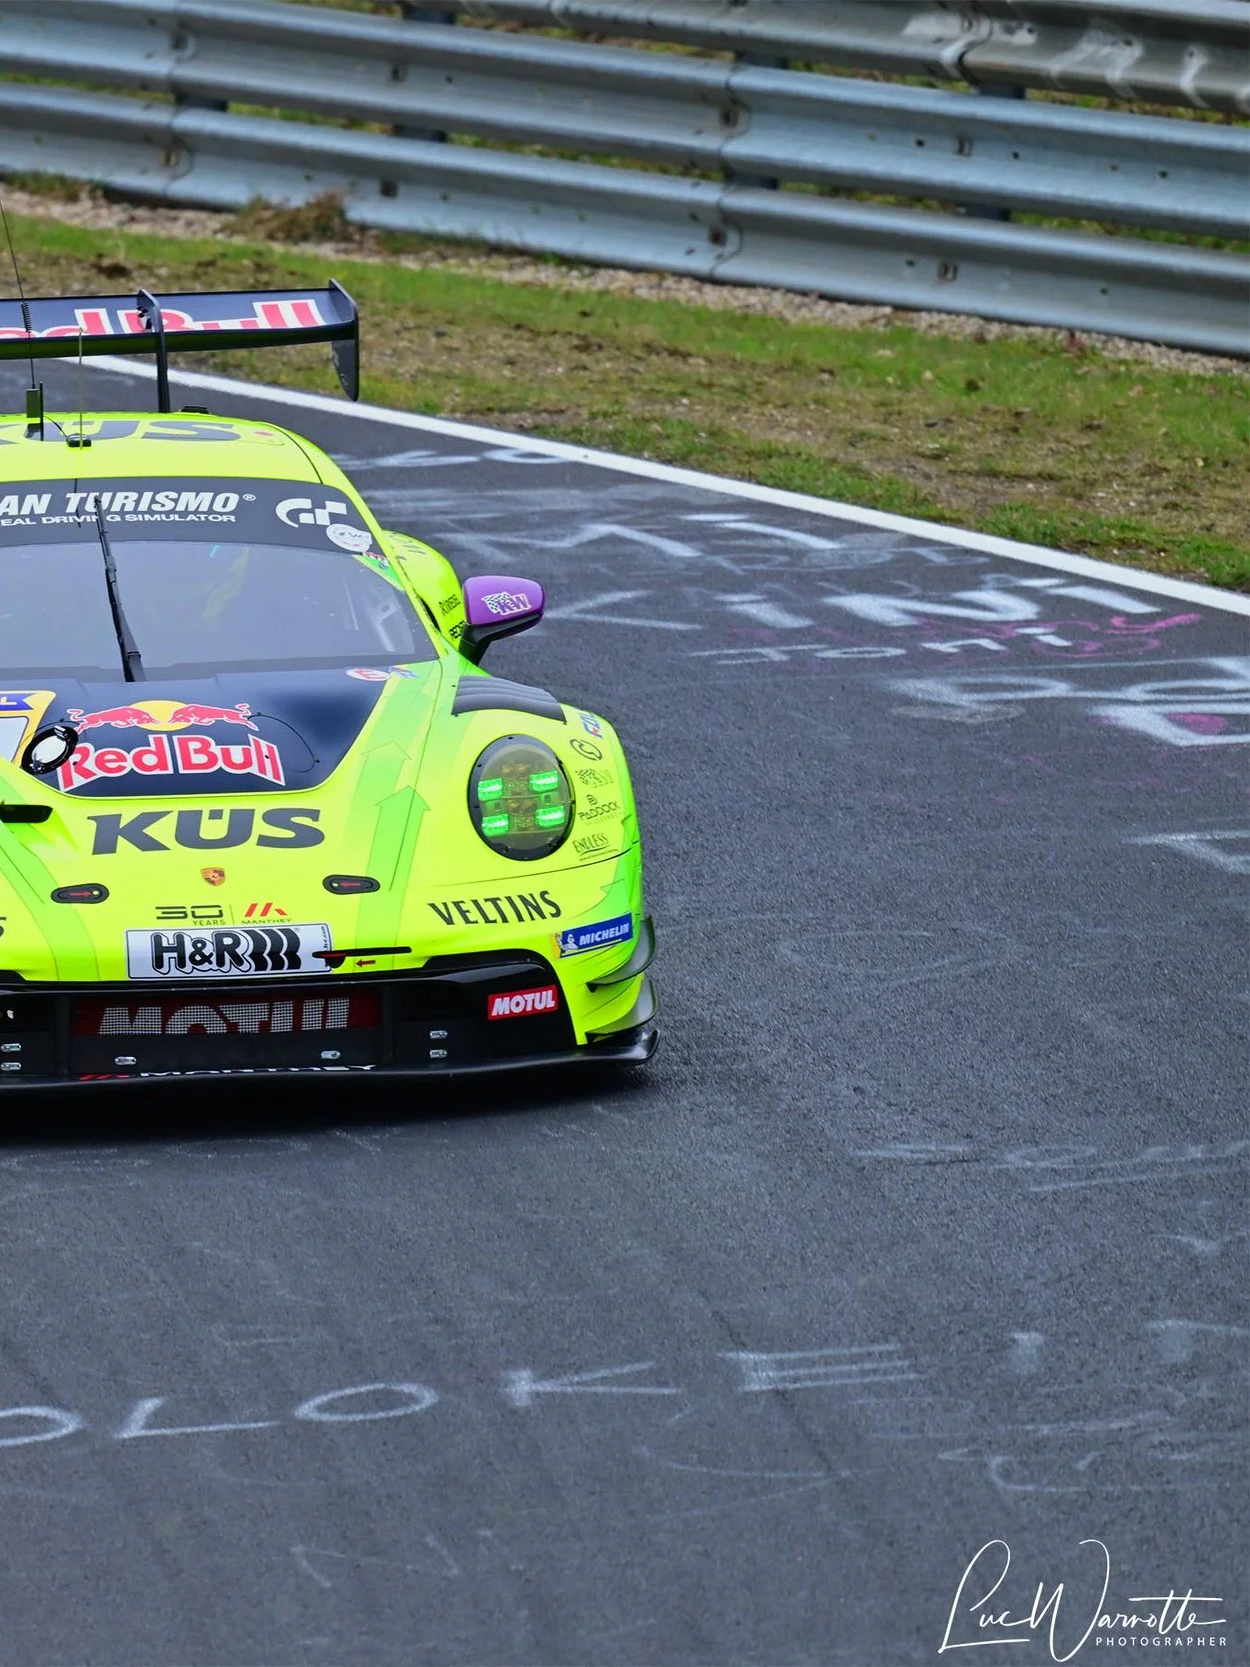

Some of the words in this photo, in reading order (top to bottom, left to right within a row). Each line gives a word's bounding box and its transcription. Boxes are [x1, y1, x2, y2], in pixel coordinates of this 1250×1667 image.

[41, 513, 122, 525] DRIVING
[129, 513, 236, 523] SIMULATOR
[58, 734, 174, 791] Red
[172, 734, 286, 786] Bull
[87, 808, 325, 856] KÜS
[572, 833, 609, 854] ENDLESS
[154, 904, 224, 920] 30
[241, 917, 292, 925] MANTHEY
[427, 890, 562, 926] VELTINS
[579, 922, 630, 946] MICHELIN
[150, 930, 252, 976] H&R
[490, 989, 556, 1017] MOTUL
